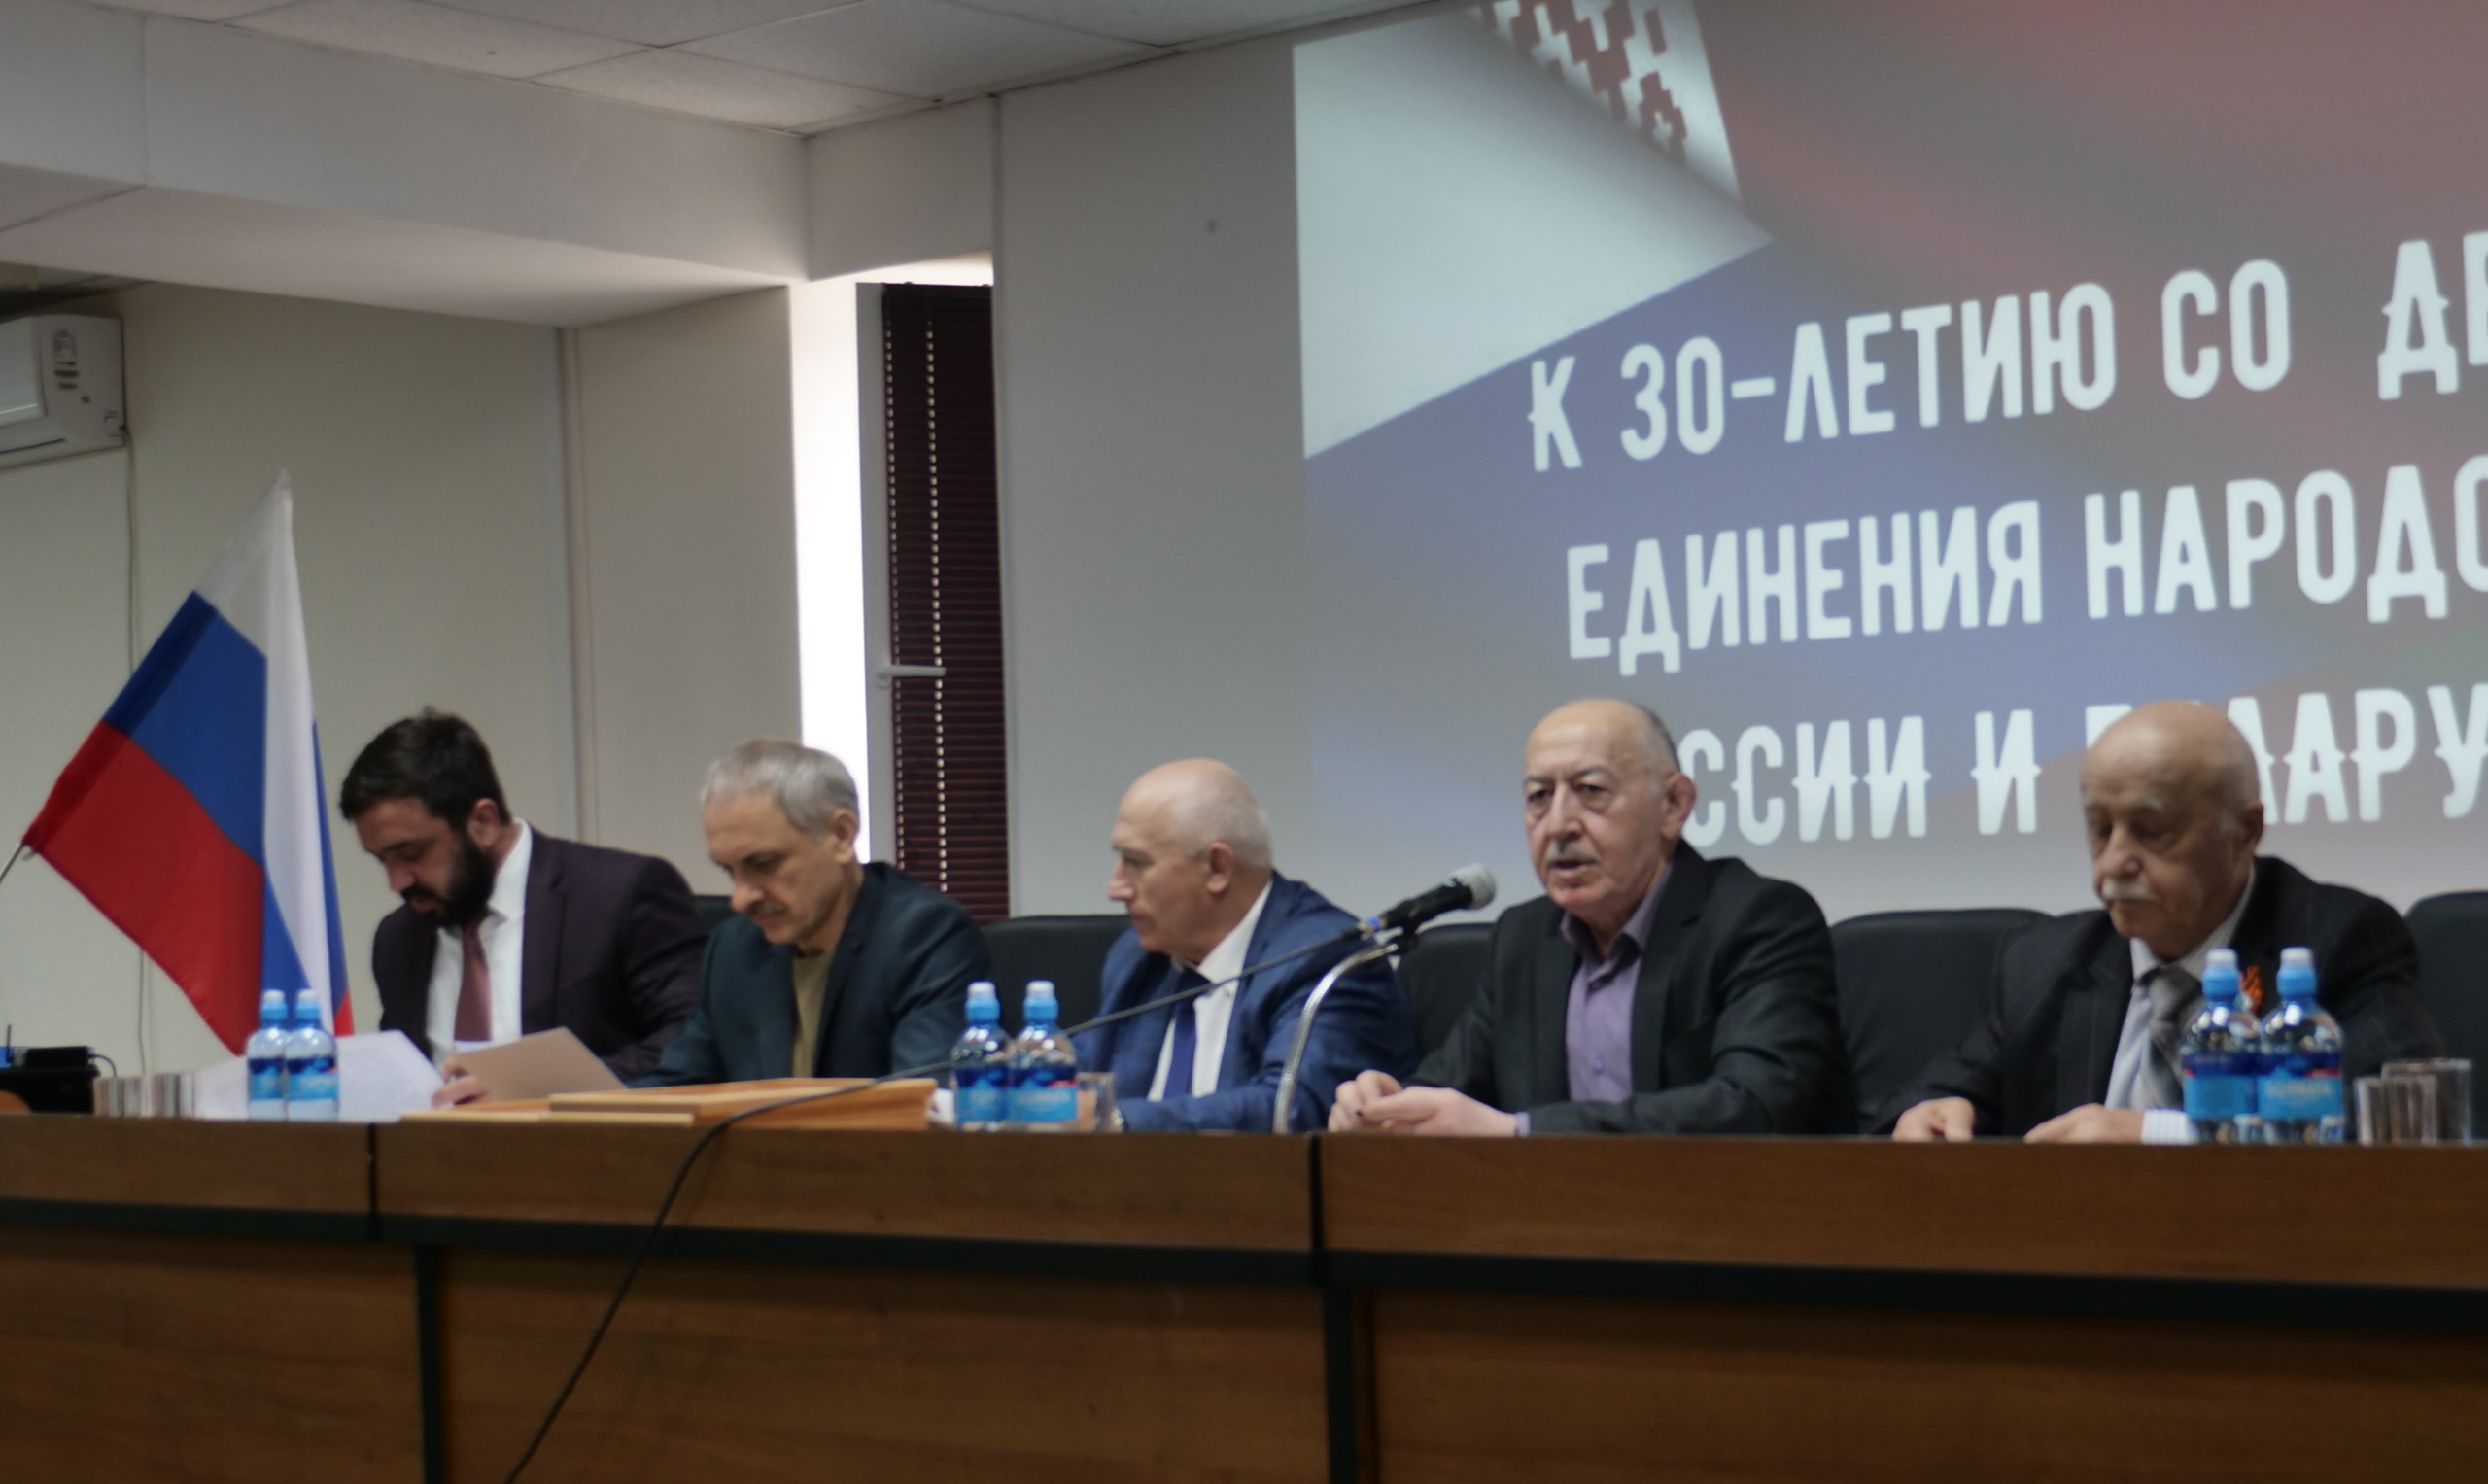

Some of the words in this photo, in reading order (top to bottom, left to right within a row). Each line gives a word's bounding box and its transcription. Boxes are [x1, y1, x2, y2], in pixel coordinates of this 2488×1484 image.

[1528, 356, 1582, 472] К
[1621, 282, 2116, 461] 30-ЛЕТИЮ
[2160, 259, 2291, 399] СО
[1568, 500, 2042, 676] ЕДИНЕНИЯ
[1677, 715, 1932, 847] ССИИ
[1970, 708, 2042, 835] И
